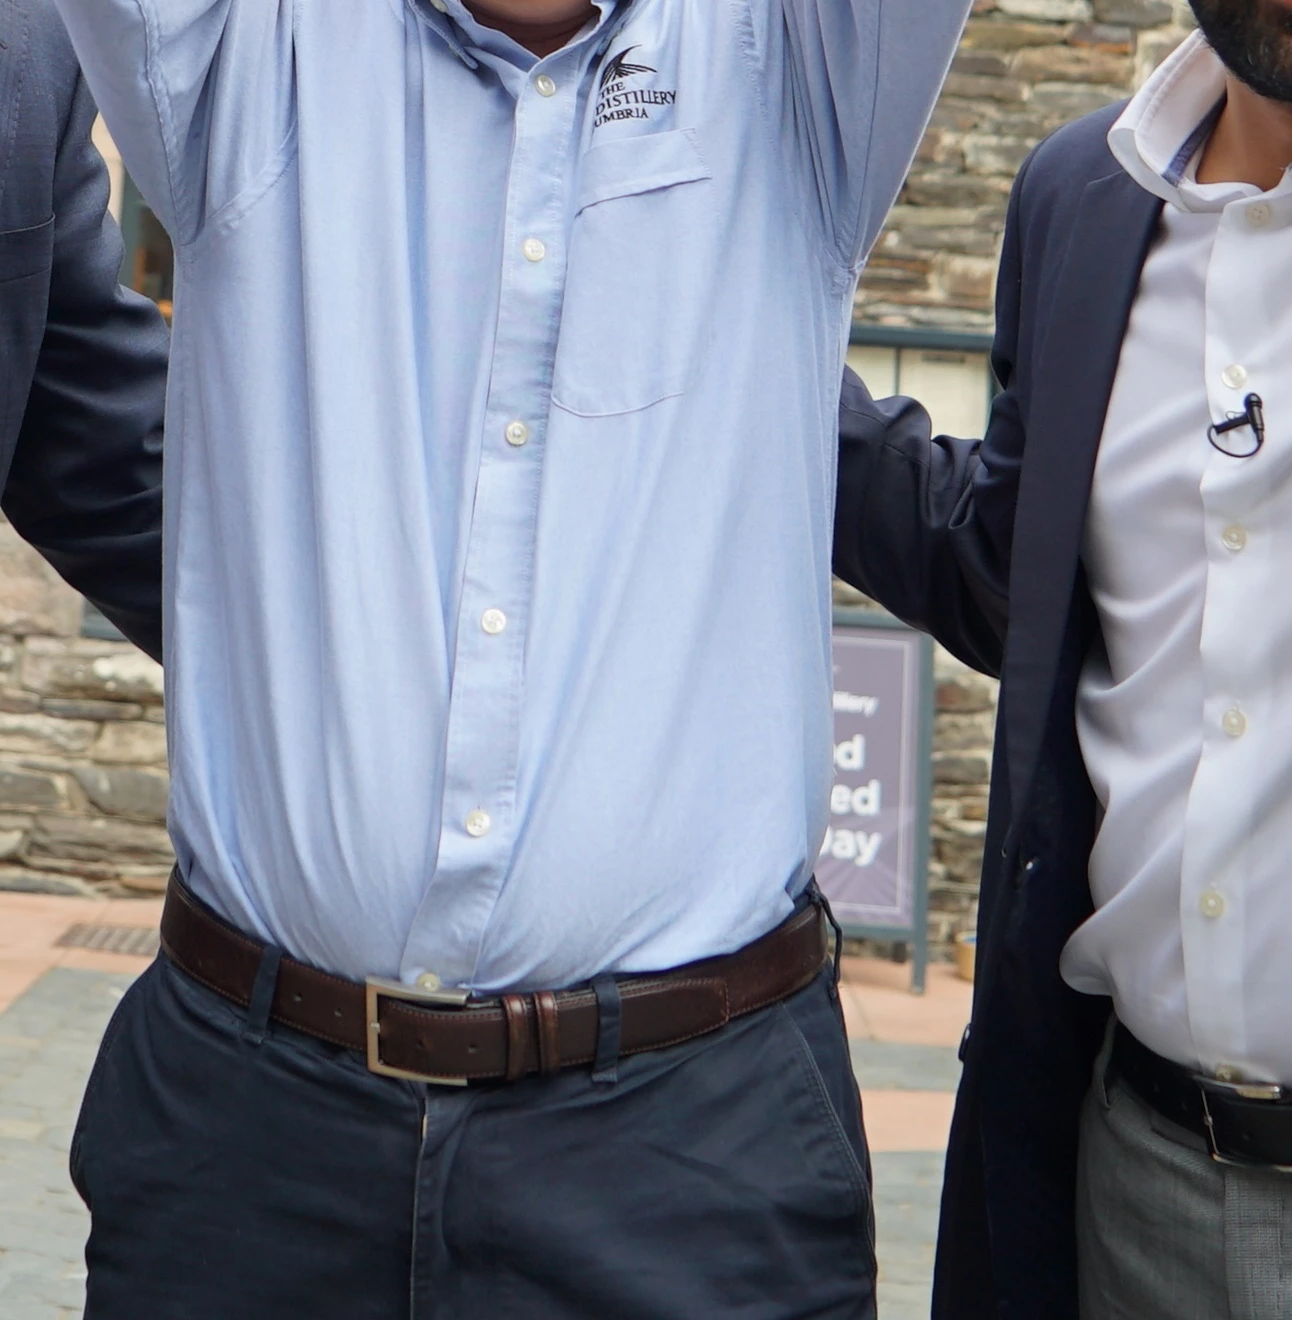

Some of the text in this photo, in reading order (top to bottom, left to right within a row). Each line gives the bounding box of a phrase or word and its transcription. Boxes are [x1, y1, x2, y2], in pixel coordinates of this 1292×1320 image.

[599, 82, 626, 99] THE
[595, 89, 677, 117] DISTILLERY
[594, 107, 649, 128] UMBRIA
